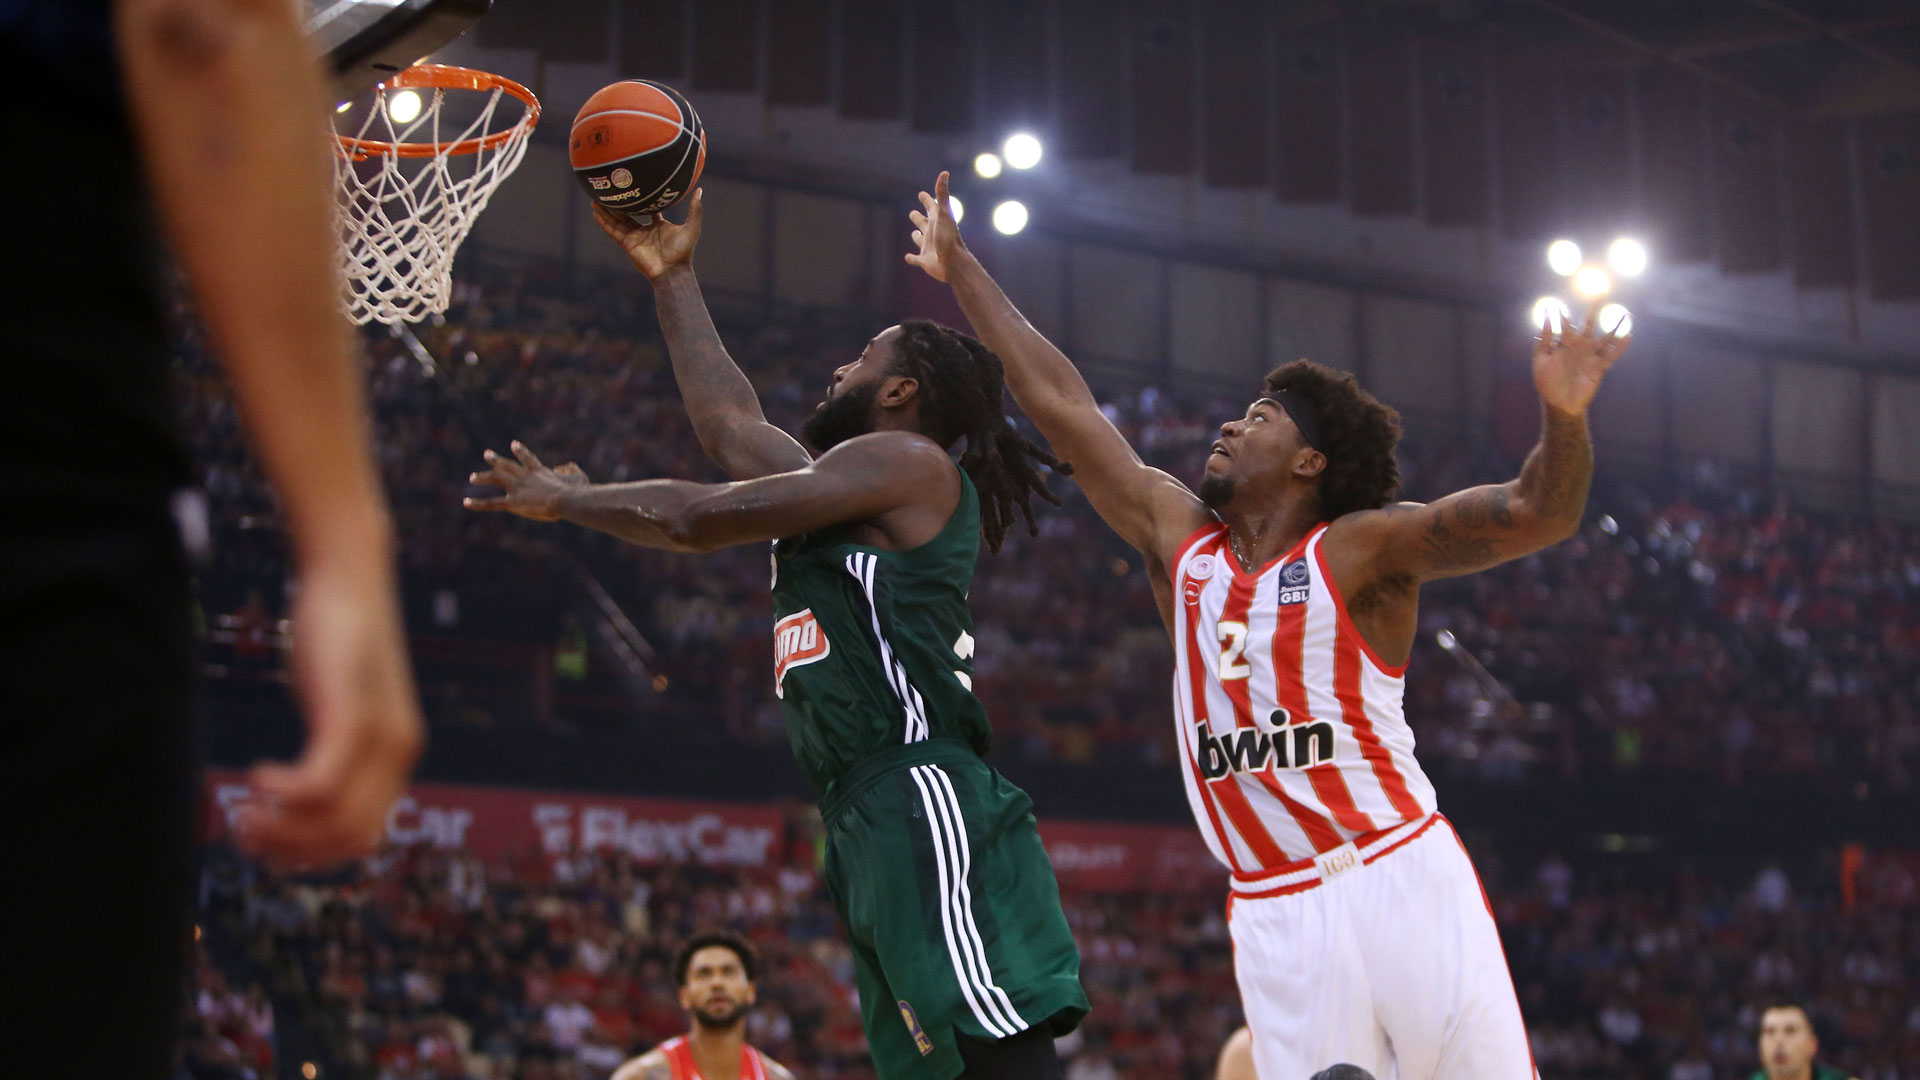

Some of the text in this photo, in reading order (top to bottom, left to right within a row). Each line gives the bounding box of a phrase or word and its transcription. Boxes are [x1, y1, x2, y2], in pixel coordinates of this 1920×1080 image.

[1280, 591, 1309, 604] GBL
[1217, 621, 1251, 680] 2
[1197, 708, 1334, 780] bwin
[580, 806, 775, 866] FlexCar
